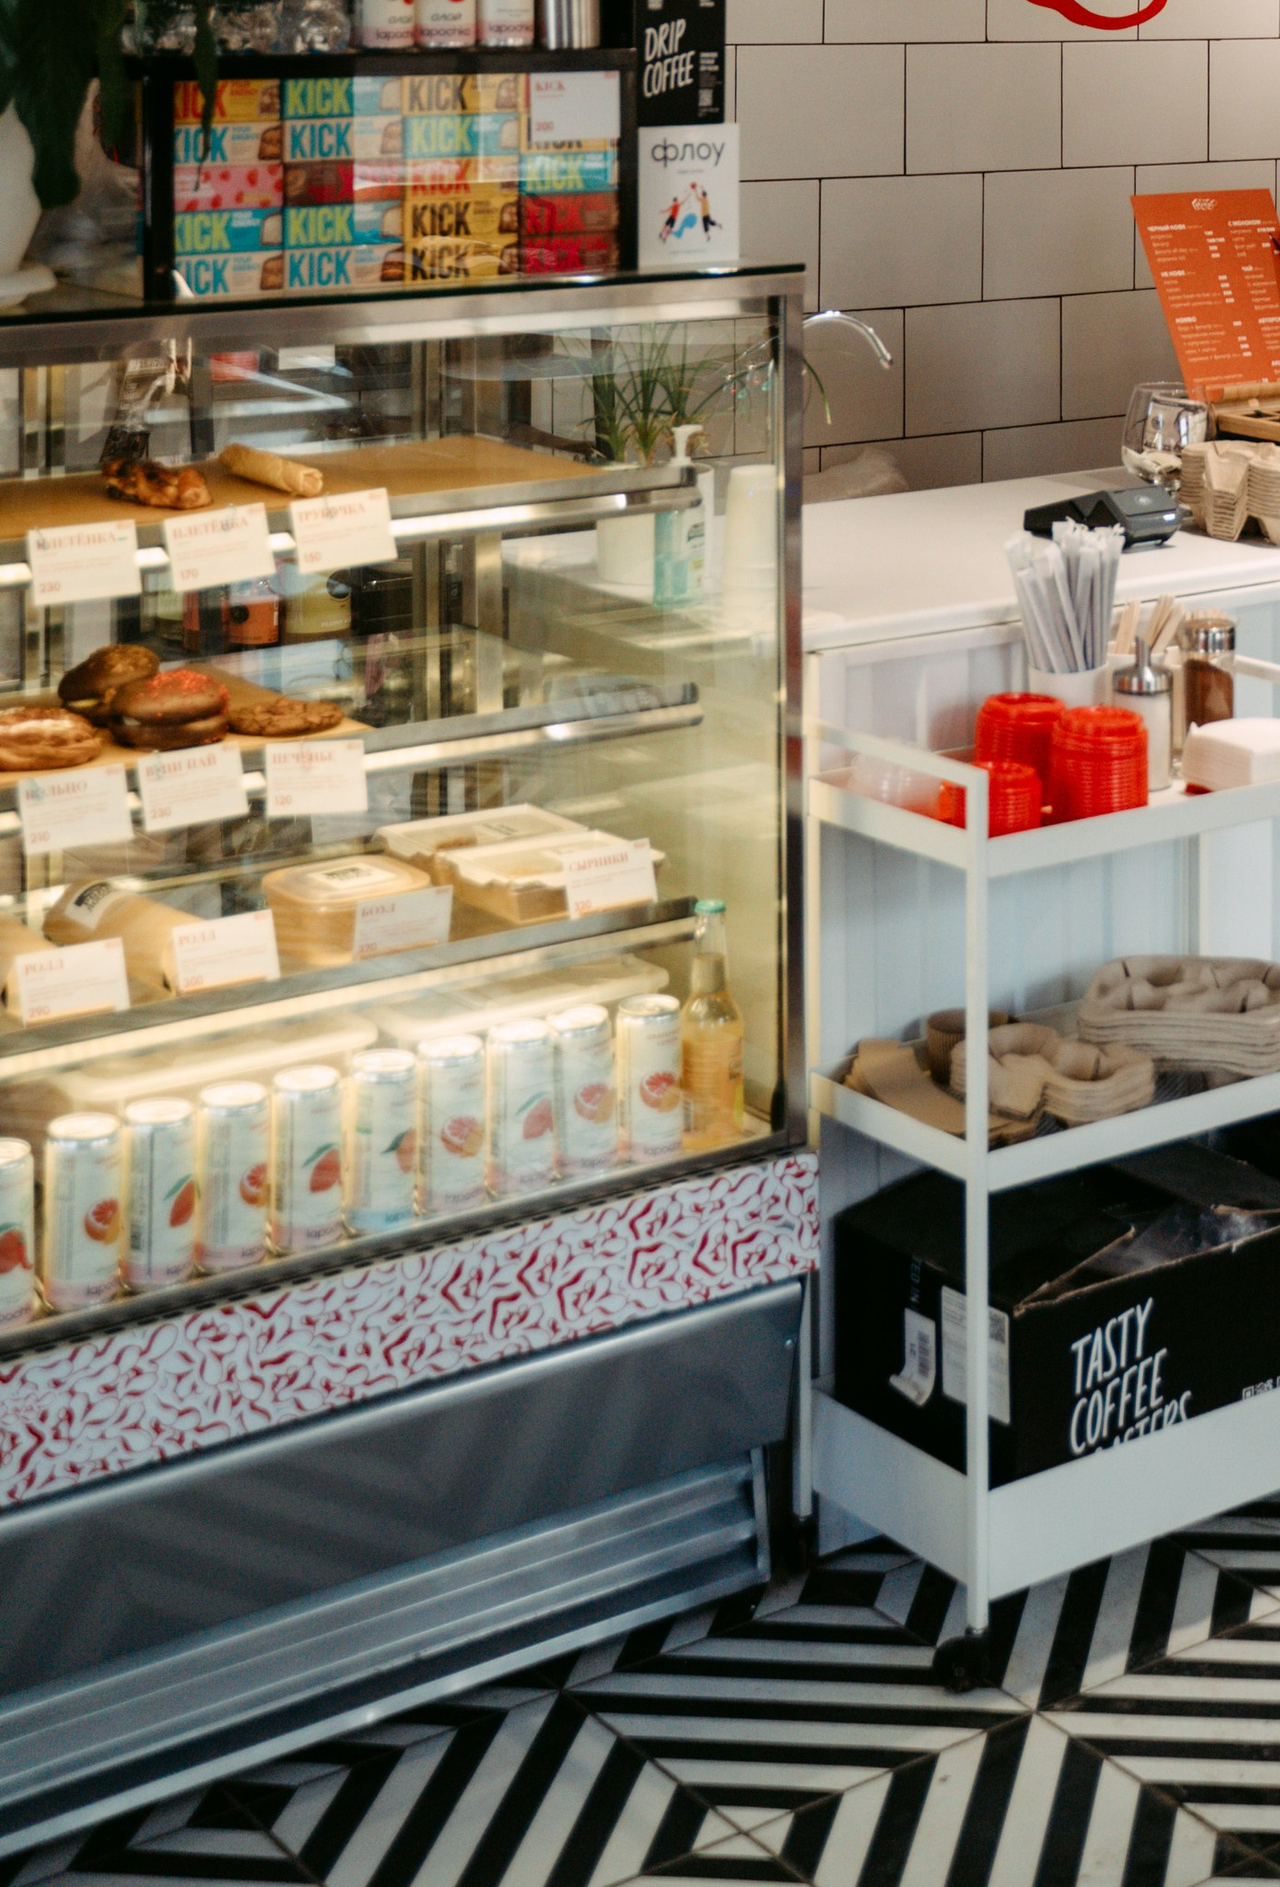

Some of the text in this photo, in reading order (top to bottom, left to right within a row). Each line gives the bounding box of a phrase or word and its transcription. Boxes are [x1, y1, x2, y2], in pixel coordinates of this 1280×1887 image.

[644, 18, 686, 62] DRIP
[643, 50, 696, 99] COFFEE
[287, 78, 351, 115] KICK
[409, 76, 468, 112] KICK
[290, 123, 353, 160] KICK
[411, 117, 472, 154] KICK
[651, 137, 726, 168] флоу
[412, 159, 472, 197] KICK
[526, 156, 584, 191] KICK
[287, 206, 353, 246] KICK
[412, 201, 471, 239] KICK
[526, 196, 585, 236] KICK
[288, 250, 352, 289] KICK
[411, 245, 471, 281] KICK
[1070, 1297, 1153, 1397] TASTY
[1070, 1347, 1168, 1456] COFFEE
